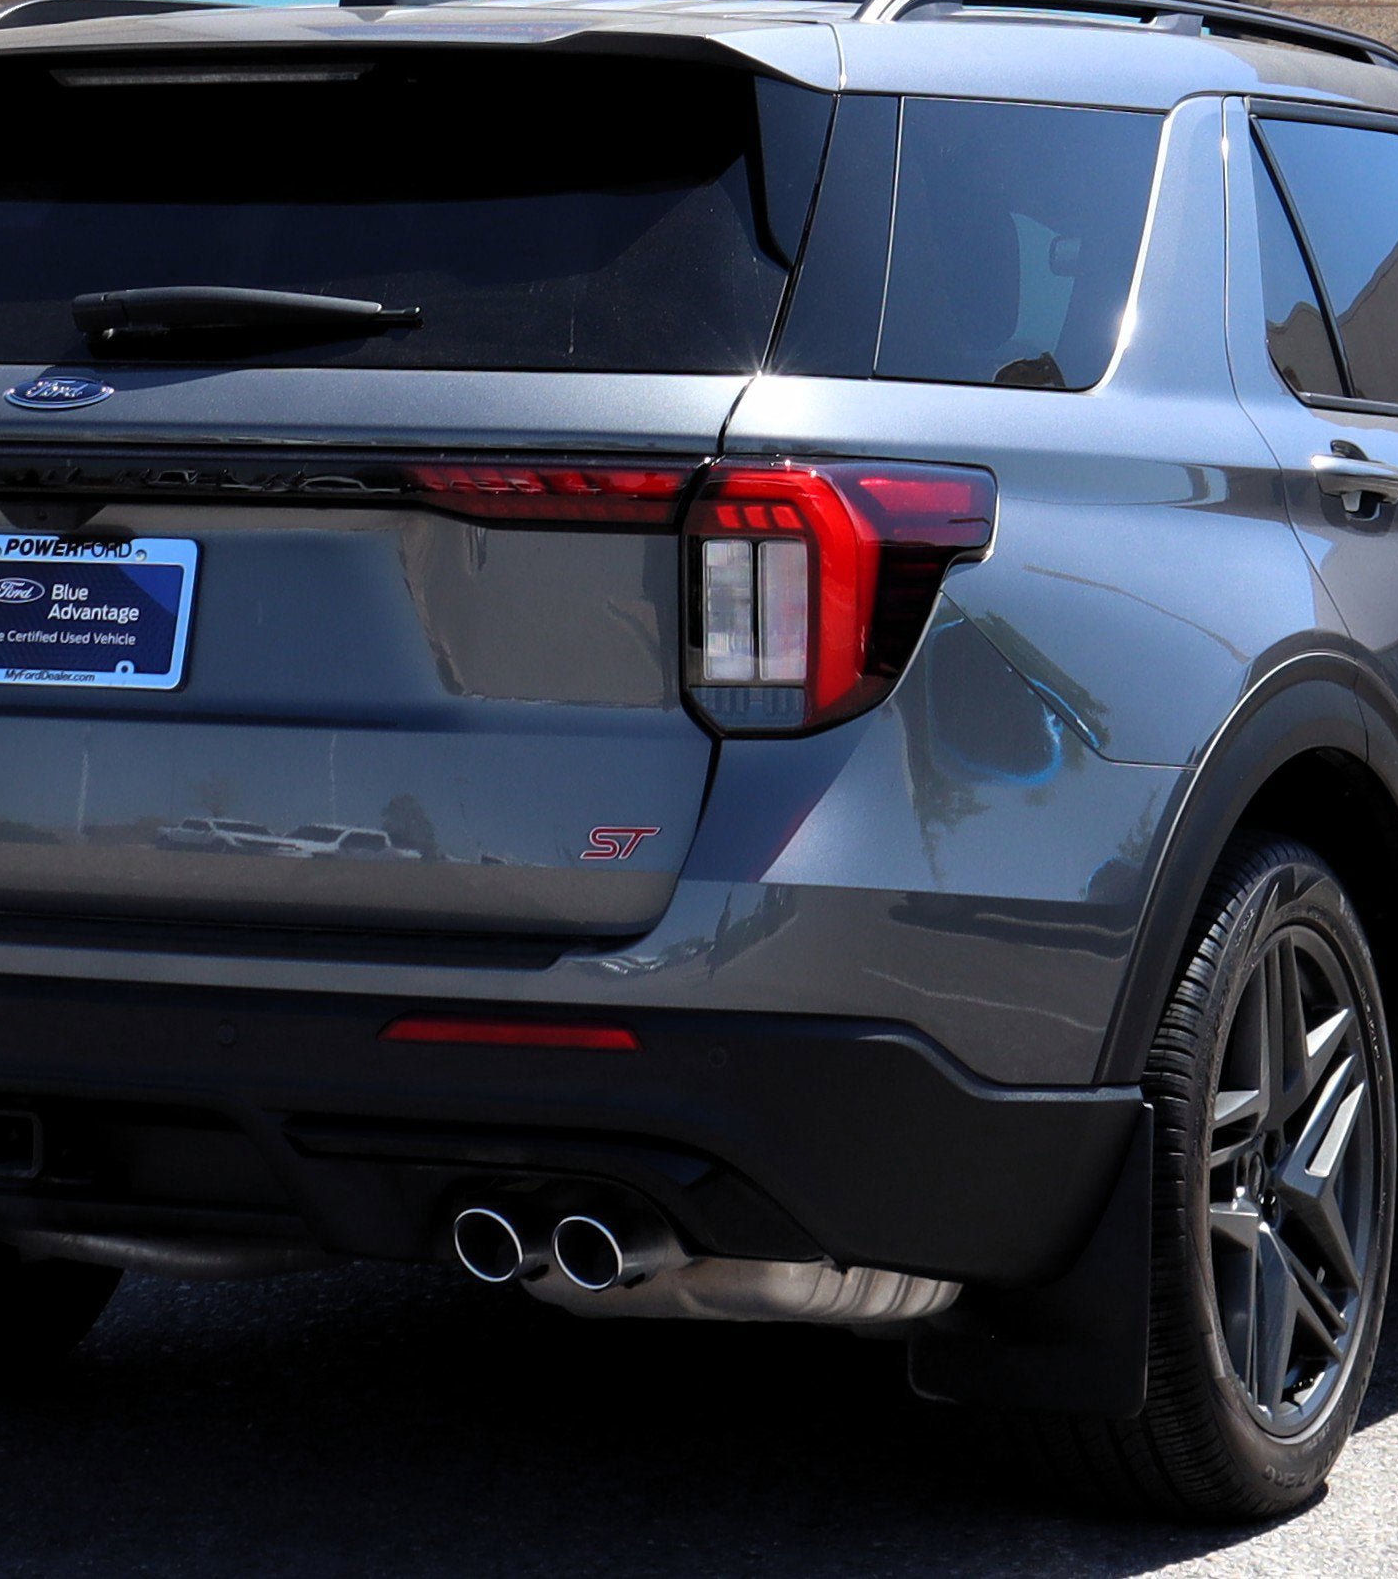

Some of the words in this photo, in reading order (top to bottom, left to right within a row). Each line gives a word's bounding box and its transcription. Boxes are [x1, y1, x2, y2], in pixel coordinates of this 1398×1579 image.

[24, 379, 90, 398] Ford
[51, 583, 89, 601] Blue
[47, 603, 140, 624] Advantage
[7, 629, 58, 643] Certified
[60, 630, 90, 644] Used
[93, 632, 136, 645] Vehicle
[4, 669, 96, 682] MyFordDealer.com
[580, 826, 661, 860] ST
